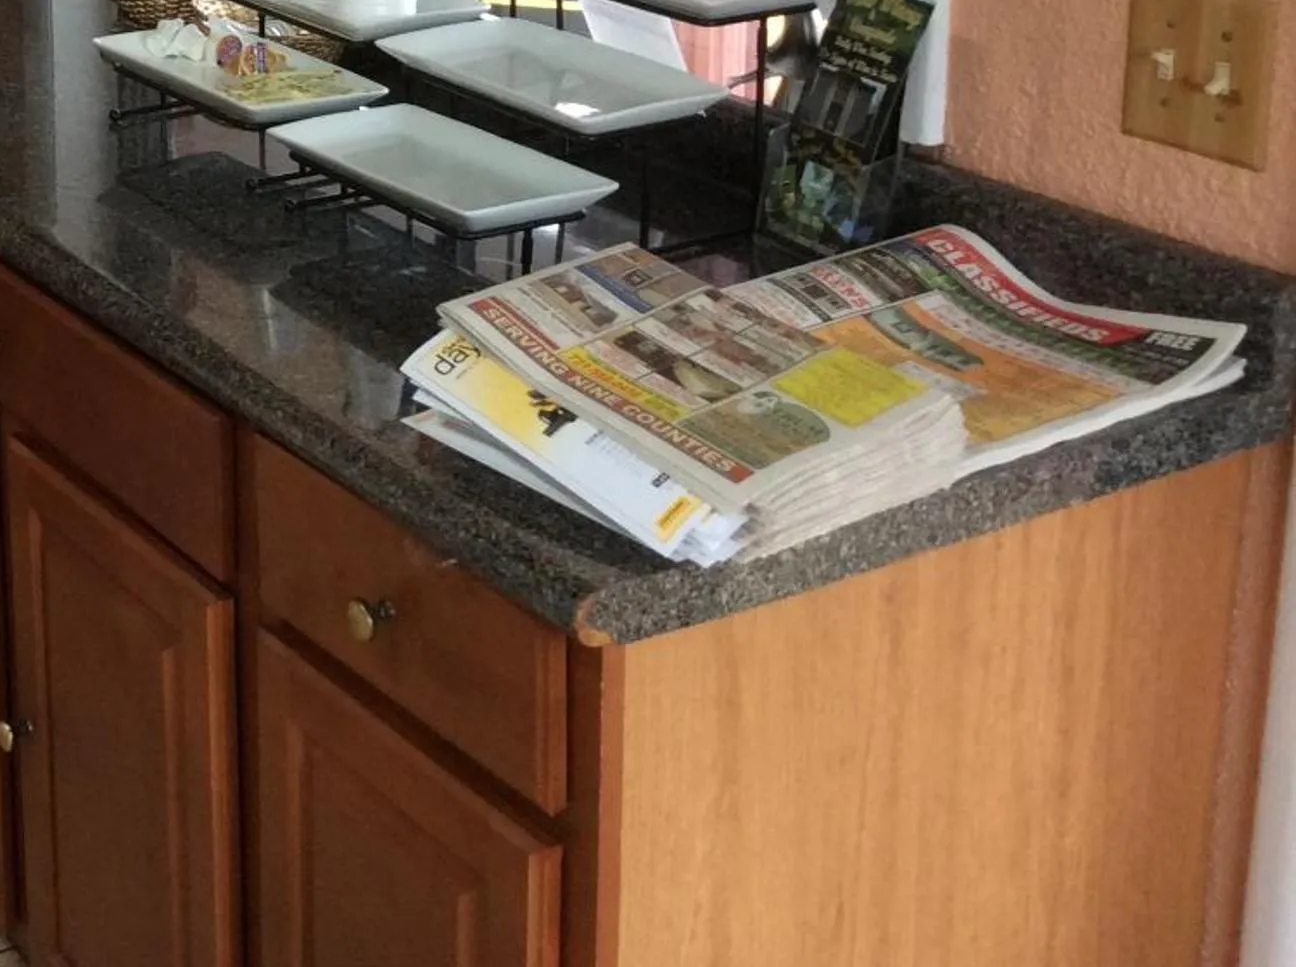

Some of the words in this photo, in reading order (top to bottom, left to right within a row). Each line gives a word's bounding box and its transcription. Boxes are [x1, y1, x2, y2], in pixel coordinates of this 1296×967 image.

[926, 238, 1109, 344] CLASSIFIEDS
[1144, 330, 1198, 352] FREE
[483, 305, 569, 376] SERVING
[568, 375, 623, 408] NINE
[622, 403, 738, 472] COUNTIES
